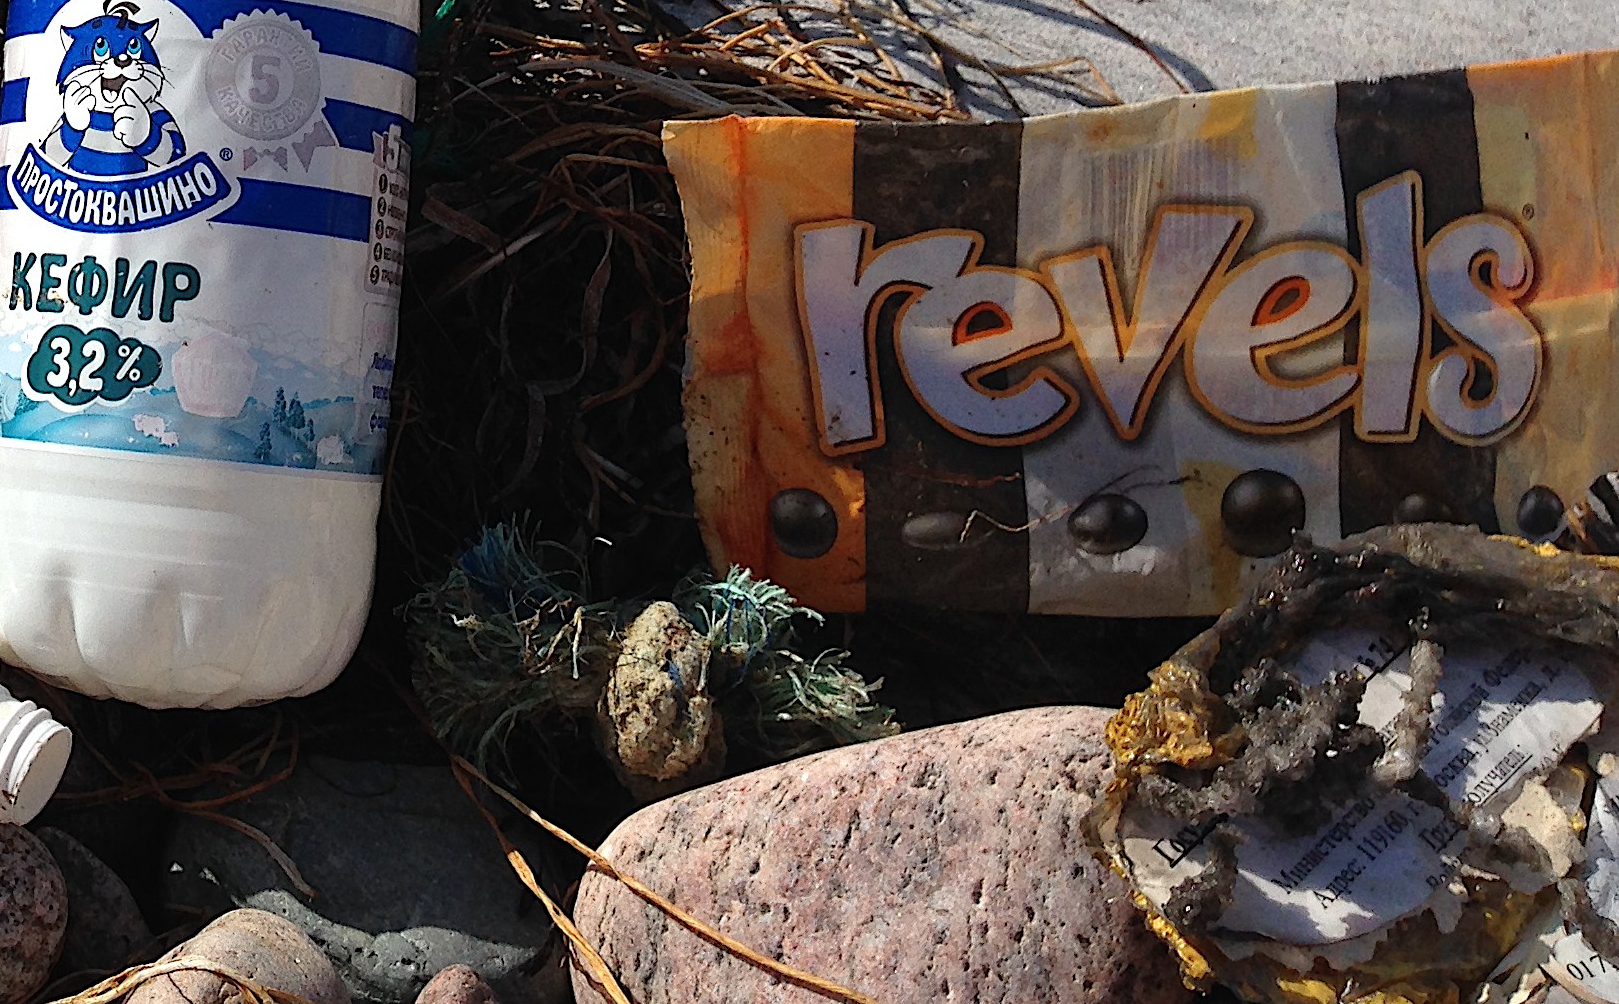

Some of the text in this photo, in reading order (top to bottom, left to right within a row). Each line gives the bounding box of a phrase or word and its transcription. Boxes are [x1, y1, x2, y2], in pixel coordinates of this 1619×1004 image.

[248, 55, 281, 105] 5
[16, 151, 219, 227] ПРОСТОКВАШИНО
[8, 252, 202, 323] КЕФИР
[795, 171, 1545, 456] revels
[1273, 790, 1377, 895] Министерство
[1313, 853, 1367, 910] Адрес:
[1354, 805, 1414, 862] 119160,
[1428, 739, 1483, 792] осква,
[1566, 953, 1607, 981] 017
